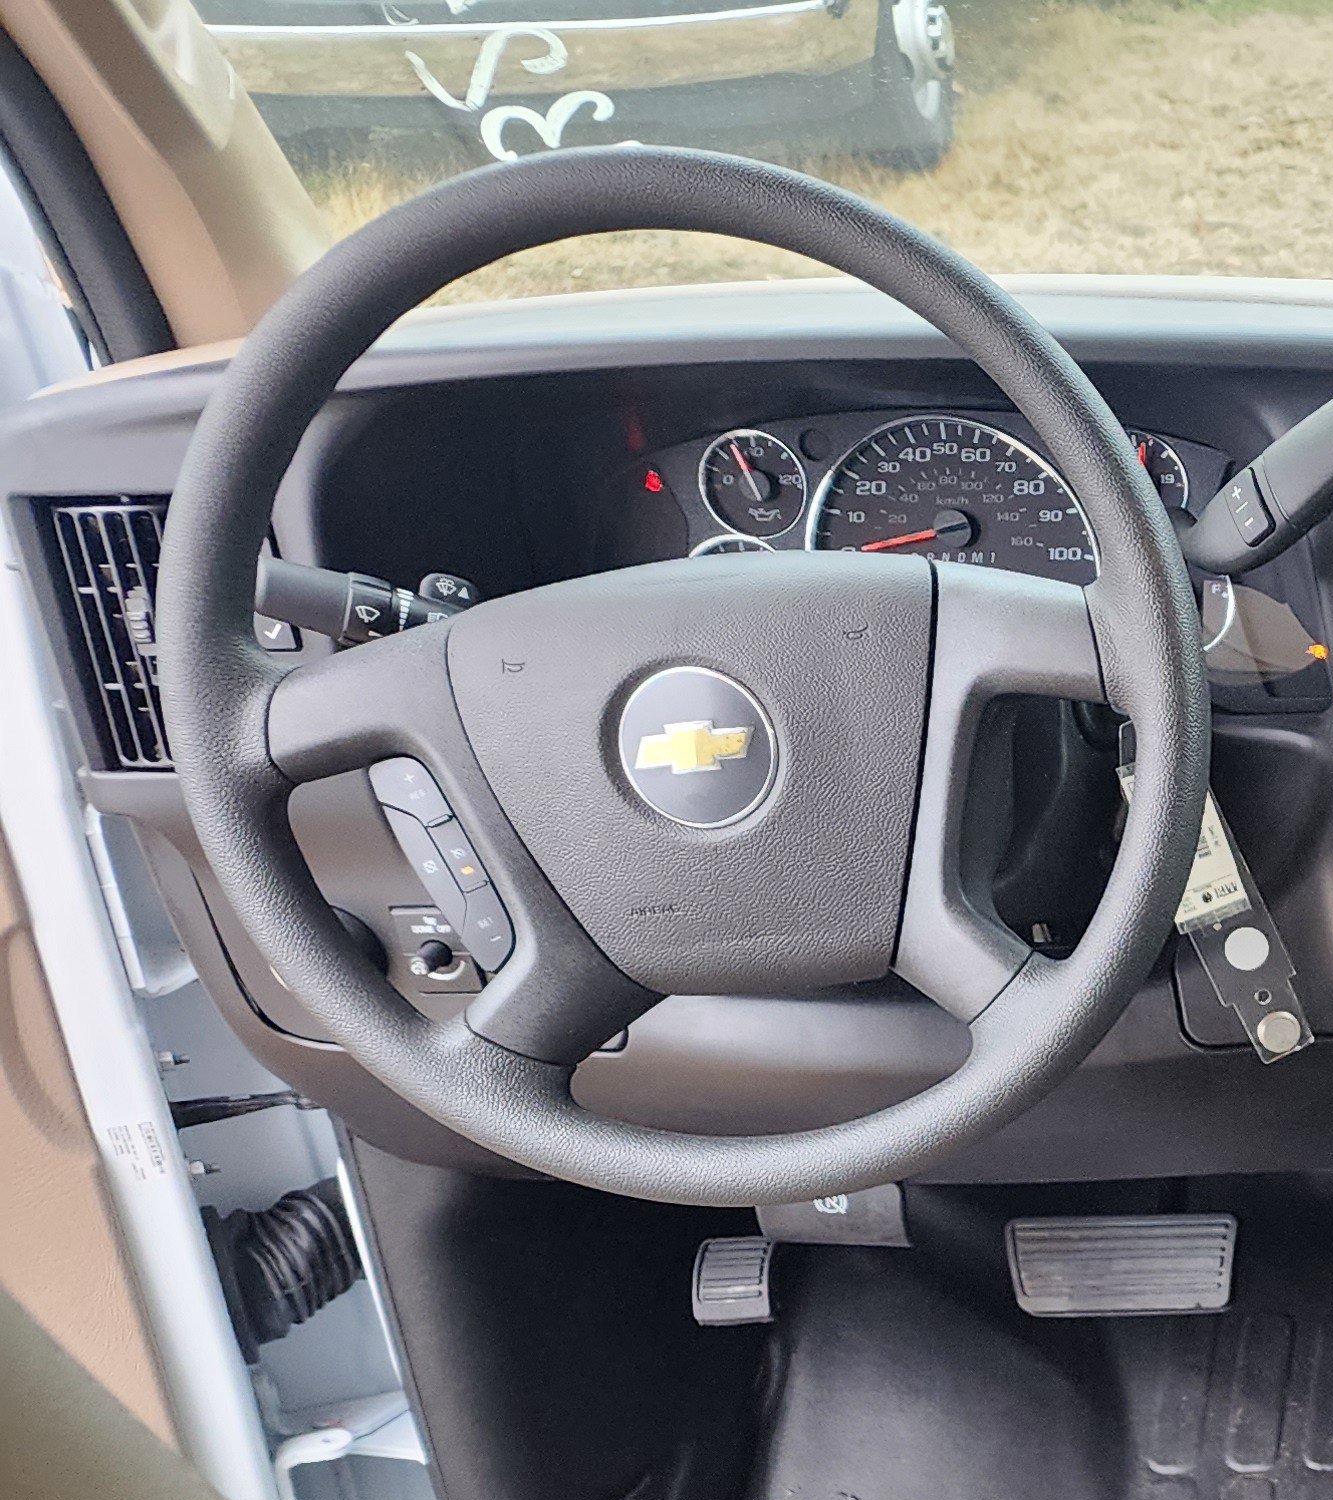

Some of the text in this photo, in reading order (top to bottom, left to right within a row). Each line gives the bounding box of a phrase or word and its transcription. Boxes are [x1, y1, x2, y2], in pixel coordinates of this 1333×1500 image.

[898, 446, 932, 462] 40
[932, 442, 959, 455] 50
[961, 447, 991, 462] 60
[877, 461, 901, 473] 30
[995, 461, 1017, 473] 70
[1160, 473, 1175, 484] 19
[856, 480, 887, 496] 20
[1013, 480, 1045, 496] 80
[847, 510, 866, 523] 10
[1038, 510, 1063, 522] 90
[1048, 547, 1082, 561] 100
